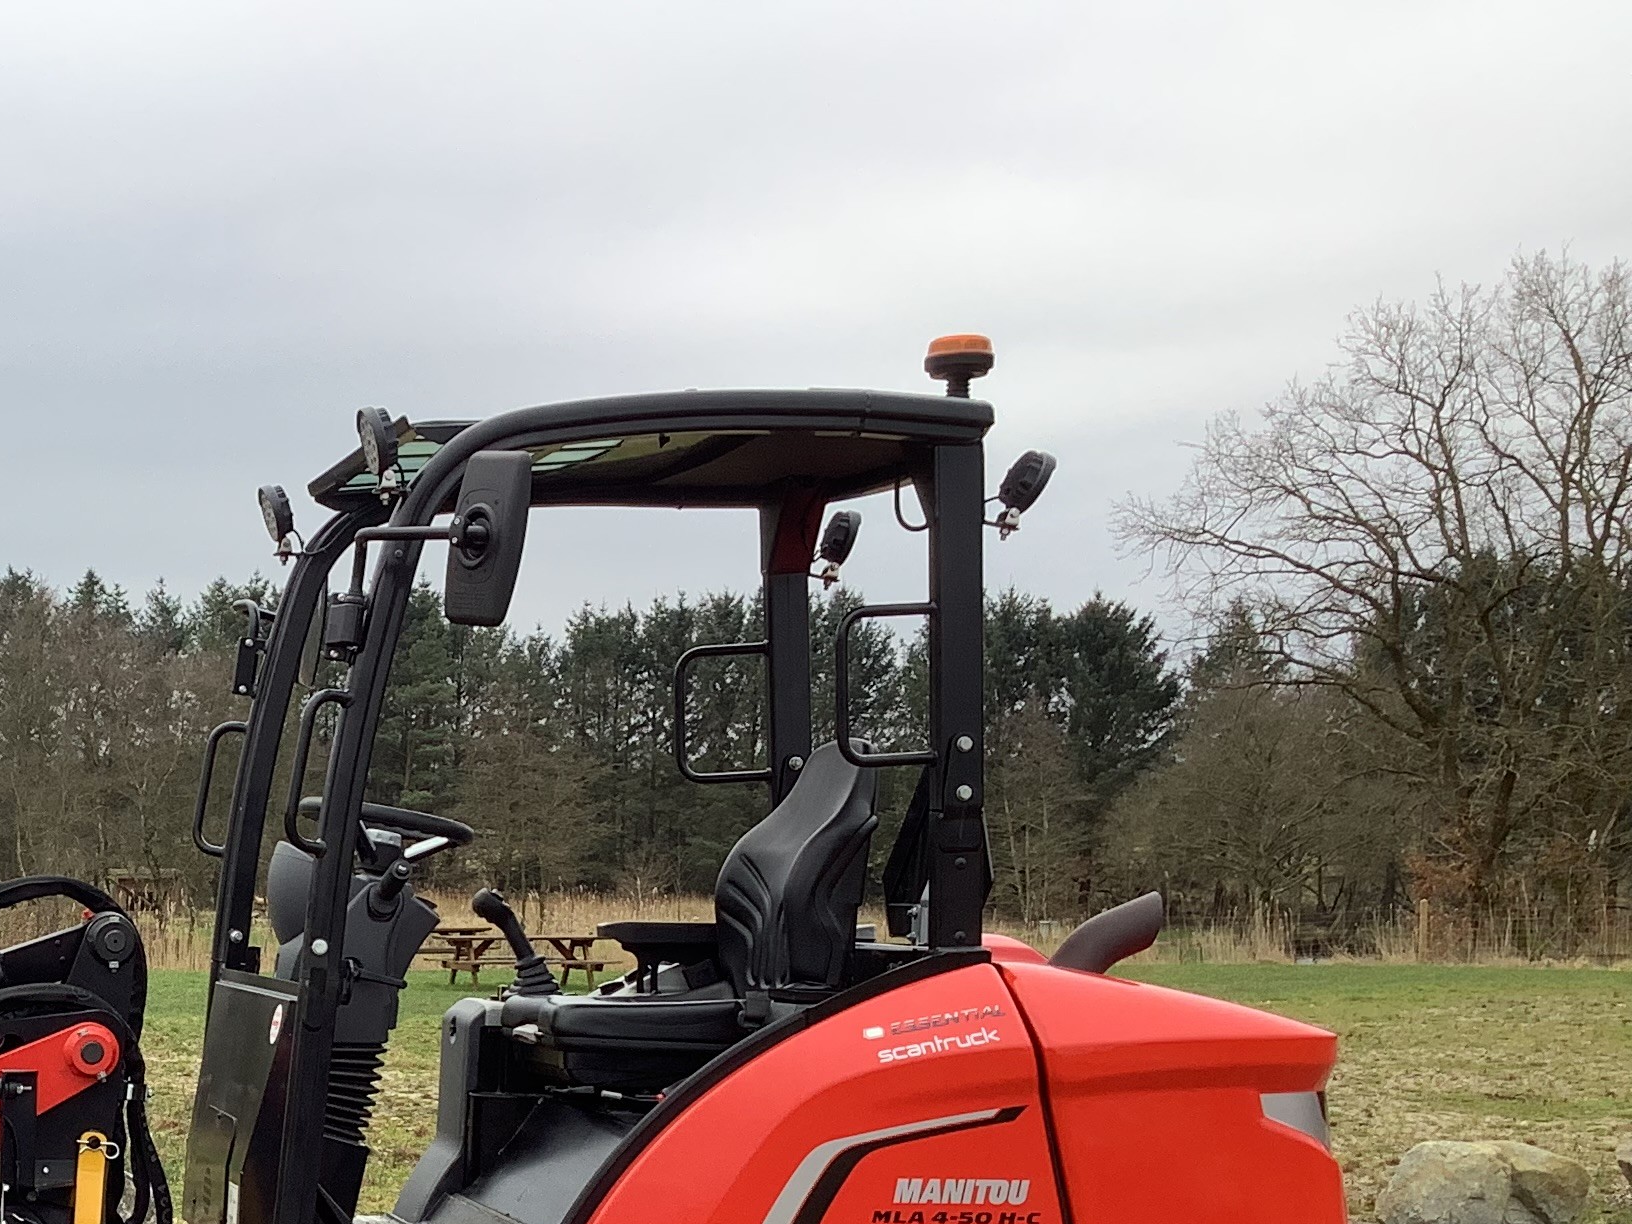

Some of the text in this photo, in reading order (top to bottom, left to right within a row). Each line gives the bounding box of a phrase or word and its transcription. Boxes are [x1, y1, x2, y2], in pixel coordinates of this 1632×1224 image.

[891, 1004, 1006, 1035] ESSENTIAL
[877, 1026, 1001, 1063] scantruck
[892, 1178, 1031, 1206] MANITOU
[871, 1210, 925, 1224] MLA
